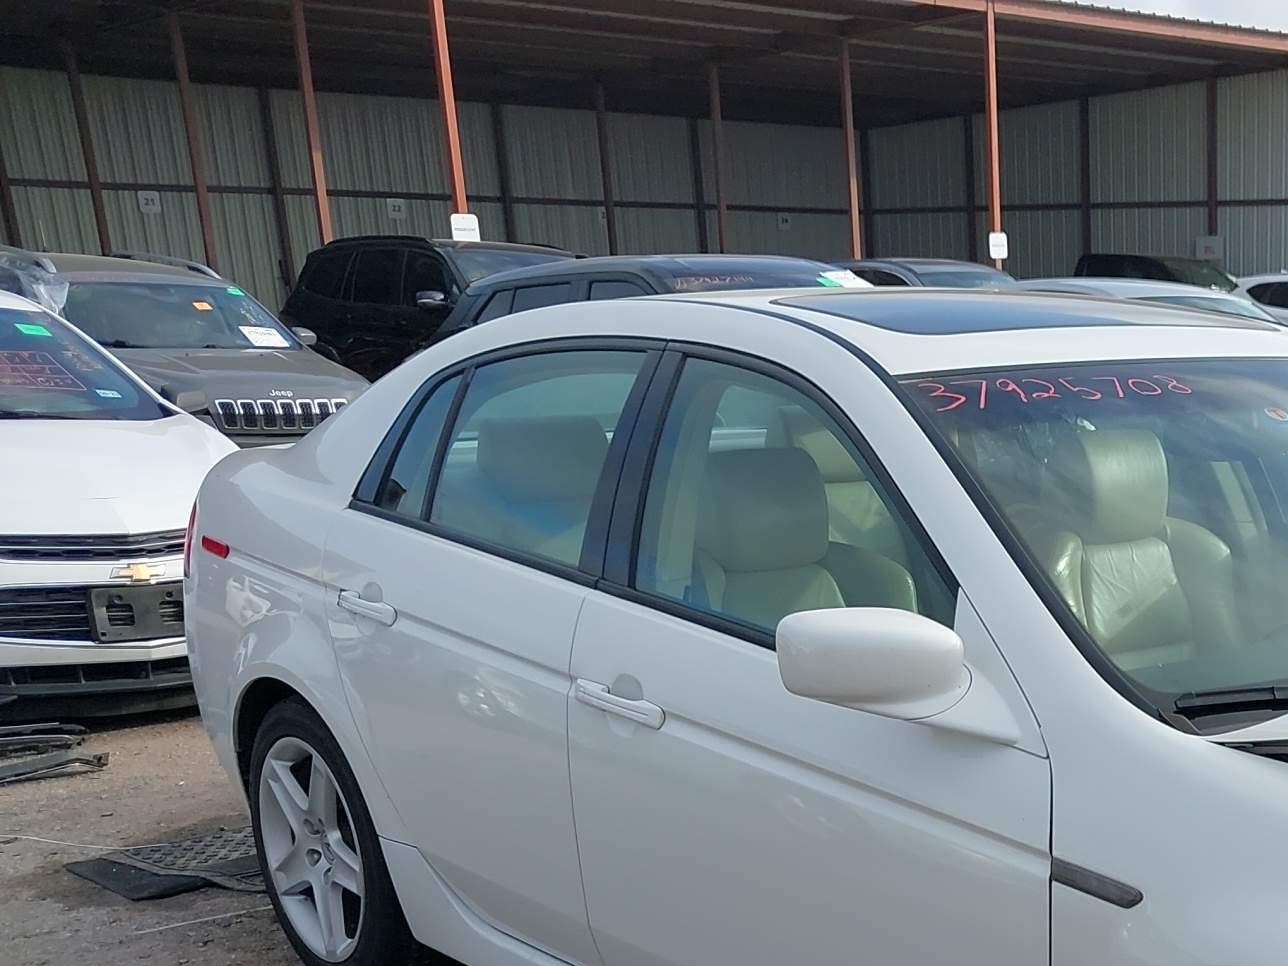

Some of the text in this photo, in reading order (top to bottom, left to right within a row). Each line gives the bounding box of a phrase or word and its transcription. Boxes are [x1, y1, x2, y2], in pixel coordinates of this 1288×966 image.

[143, 197, 156, 207] 21
[269, 389, 293, 398] Jeep
[918, 375, 1192, 411] 37925708
